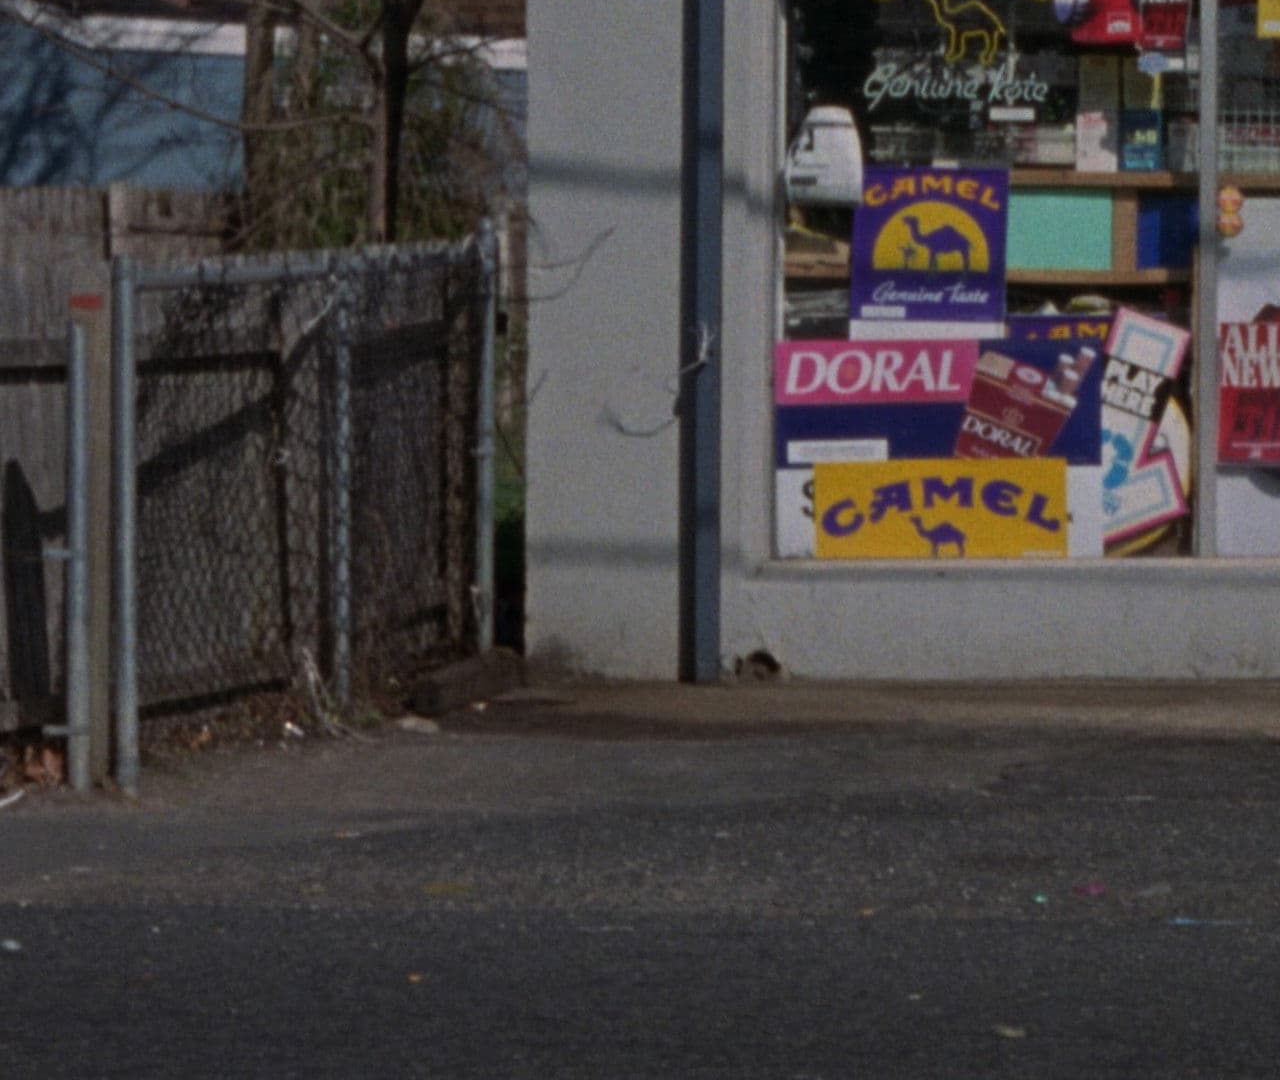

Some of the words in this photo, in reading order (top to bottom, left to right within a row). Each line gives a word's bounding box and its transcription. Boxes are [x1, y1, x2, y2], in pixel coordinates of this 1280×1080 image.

[863, 174, 1001, 212] CAMEL
[872, 280, 945, 305] Genuine
[944, 282, 989, 304] Taste
[785, 350, 962, 395] DORAL
[1104, 358, 1163, 395] PLAY
[962, 415, 1033, 456] DORAL
[821, 476, 1061, 537] CAMEL
